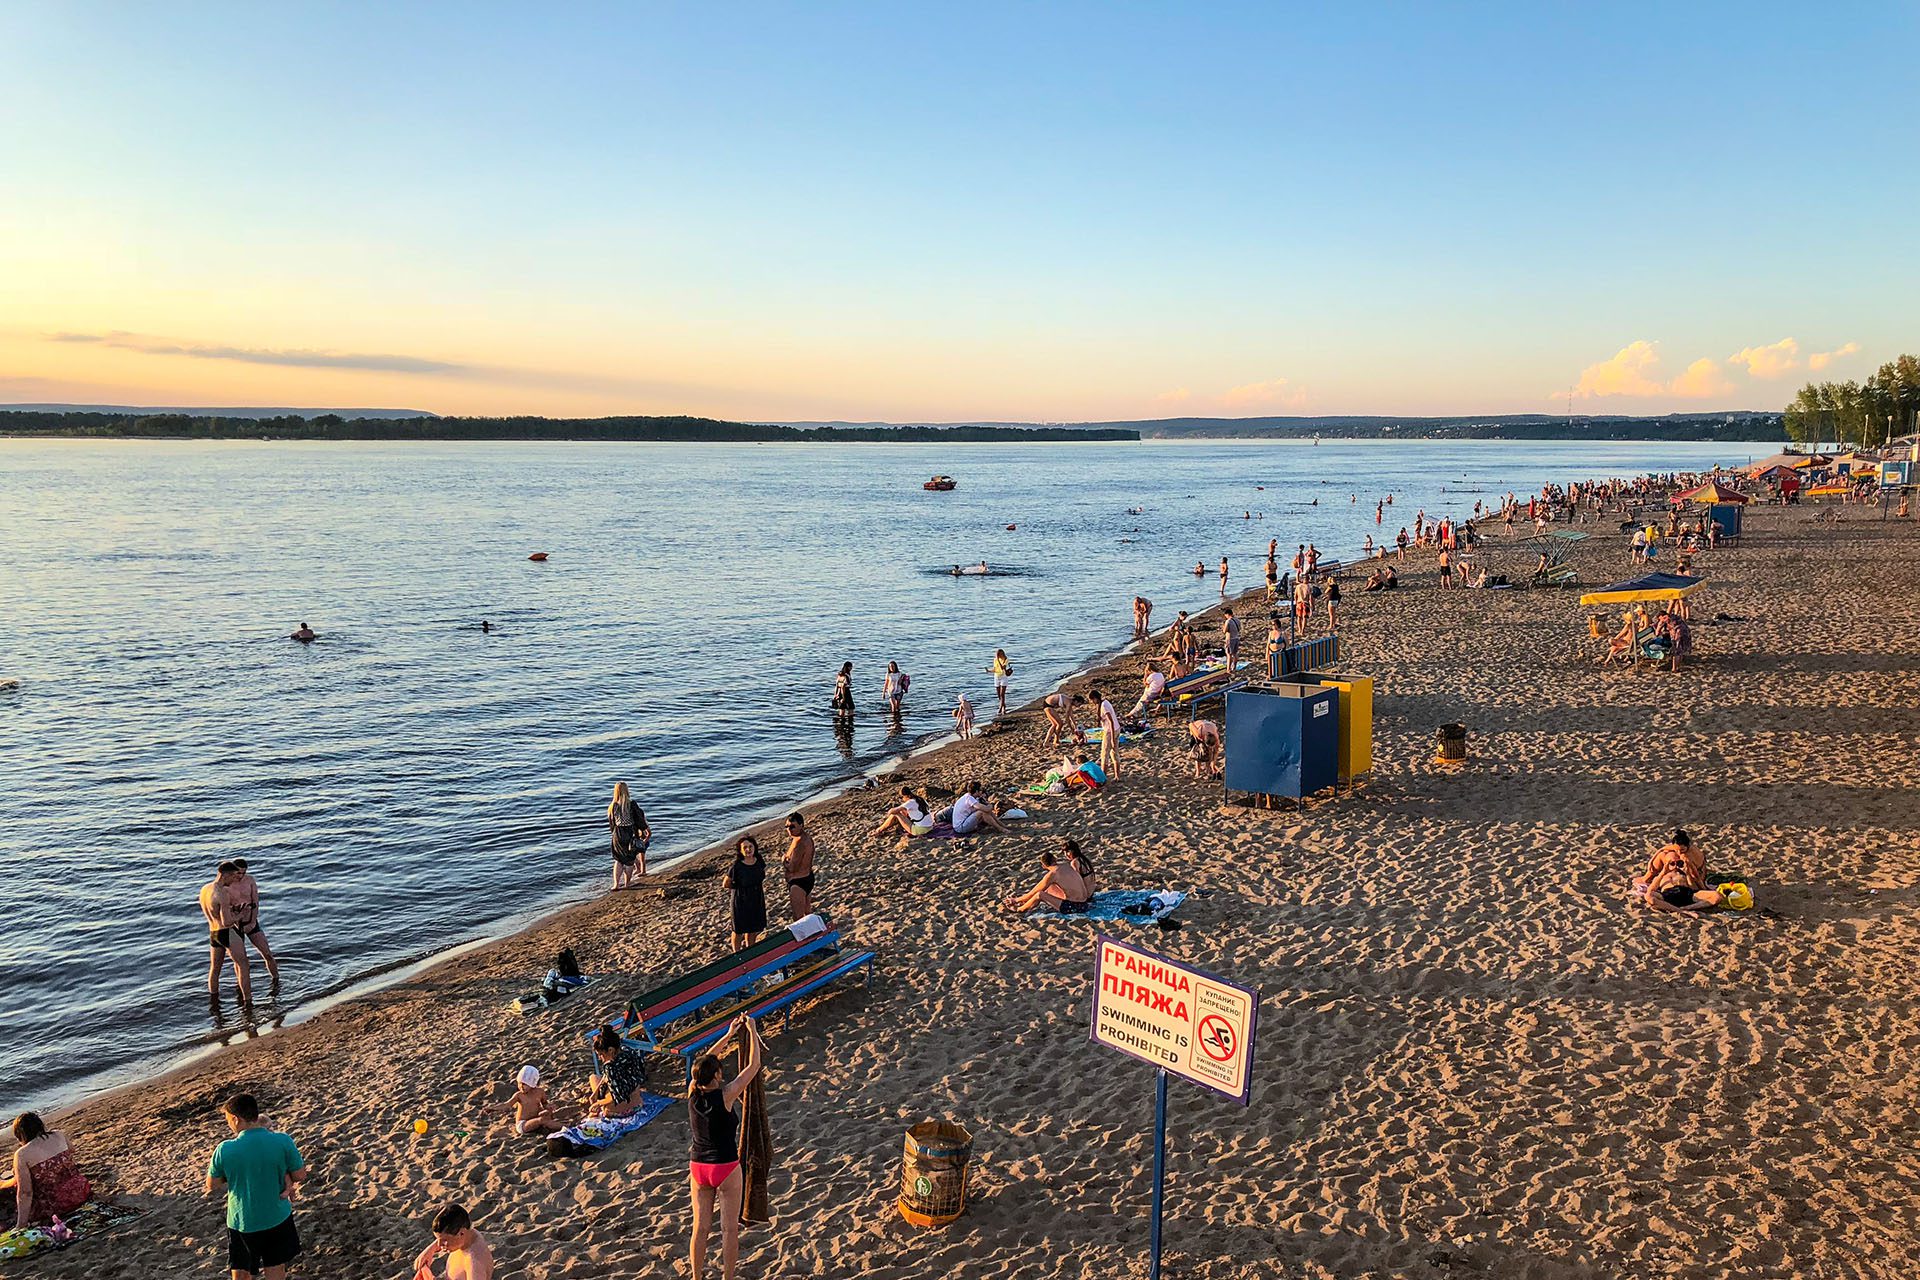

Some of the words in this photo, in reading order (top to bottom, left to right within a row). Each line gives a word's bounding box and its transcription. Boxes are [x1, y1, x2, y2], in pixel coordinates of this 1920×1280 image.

[1104, 947, 1190, 993] ГРАНИЦА
[1103, 972, 1189, 1022] ПЛЯЖА
[1199, 996, 1241, 1017] ЗАПРЕЩЕНО!
[1205, 990, 1236, 1006] КУПАНИЕ
[1101, 1005, 1171, 1040] SWIMMING
[1175, 1033, 1188, 1048] IS
[1100, 1023, 1178, 1063] PROHIBITED
[1196, 1056, 1226, 1073] SWIMMING
[1226, 1068, 1233, 1076] IS
[1196, 1063, 1231, 1082] PROHIBITED
